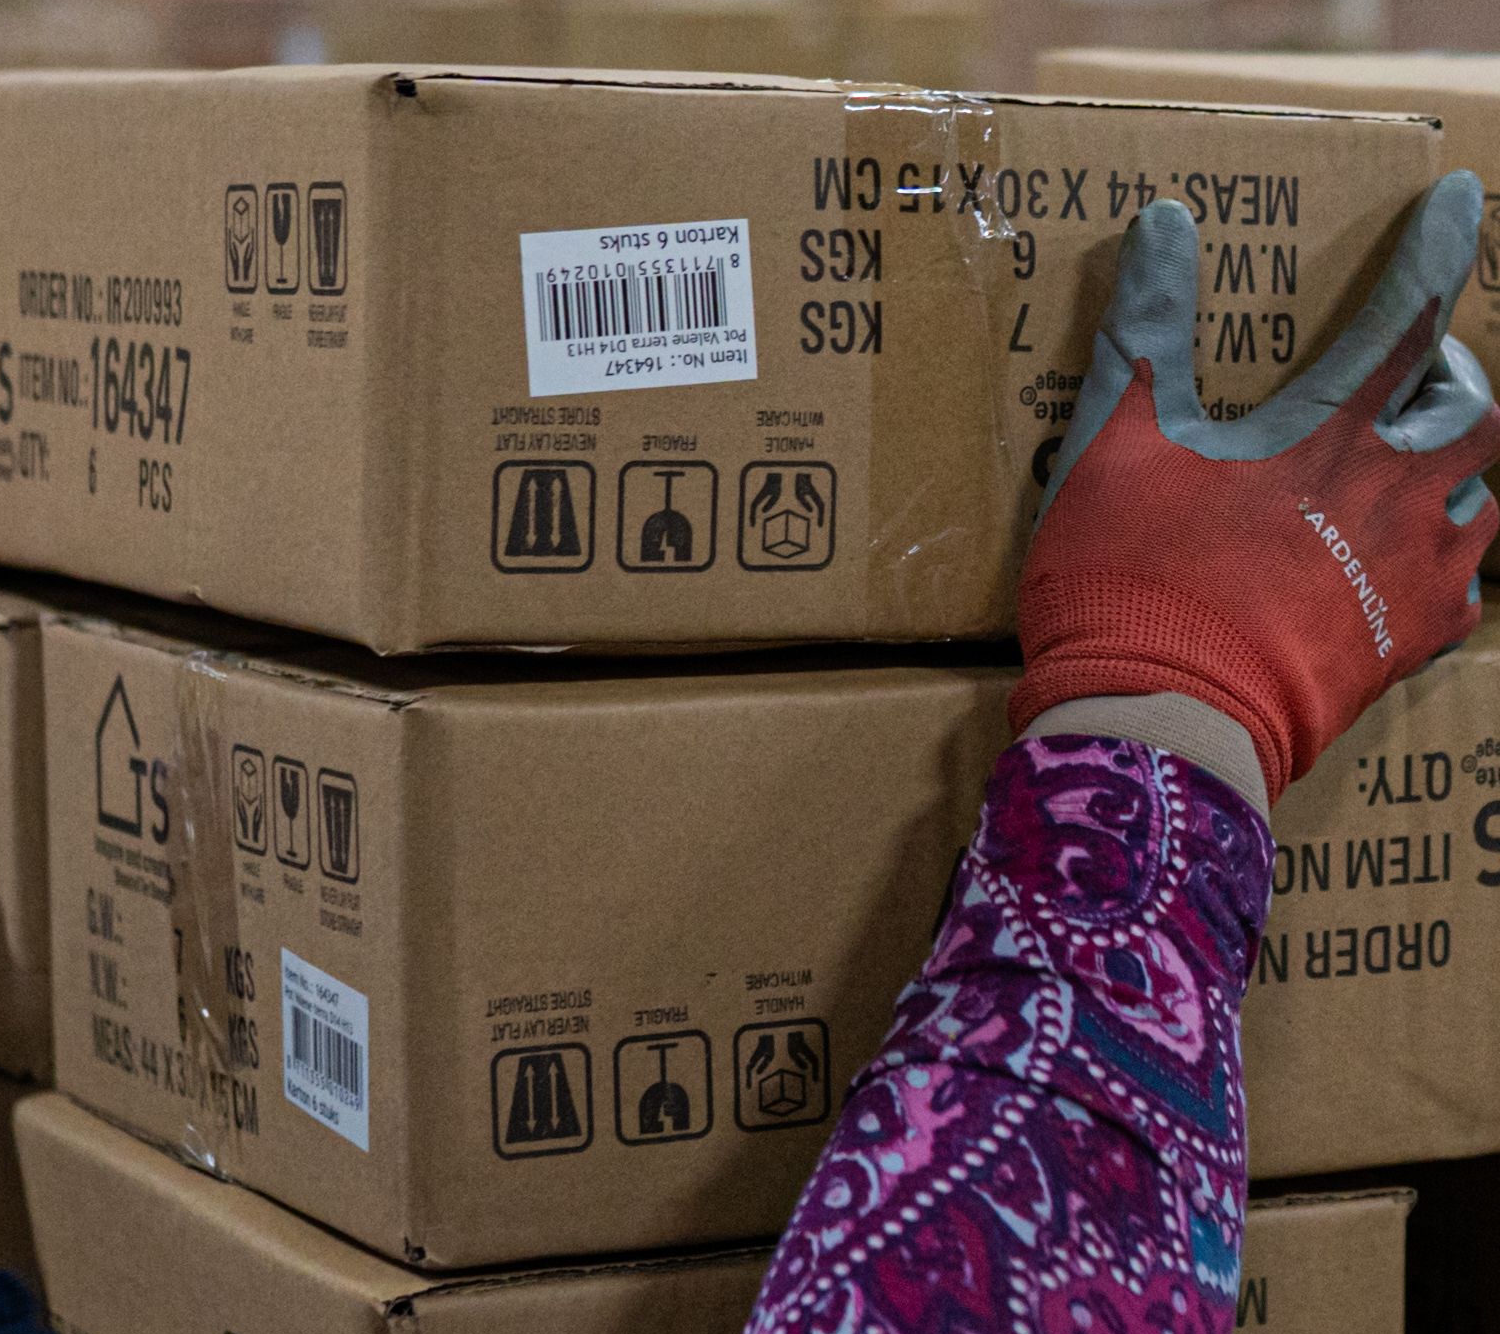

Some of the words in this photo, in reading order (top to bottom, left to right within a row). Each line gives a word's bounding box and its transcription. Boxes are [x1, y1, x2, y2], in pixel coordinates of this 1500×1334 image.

[814, 158, 880, 210] CM
[899, 162, 945, 212] 15
[1061, 171, 1088, 219] X
[1108, 175, 1153, 219] 44
[599, 232, 650, 252] stuks
[657, 232, 668, 249] 6
[675, 225, 739, 245] Karton
[731, 253, 739, 267] 8
[801, 229, 882, 282] KGS
[1012, 229, 1036, 279] 6
[547, 262, 626, 283] 010249
[638, 255, 714, 275] 711355
[18, 272, 67, 319] ORDER
[107, 276, 182, 327] IR200993
[724, 329, 746, 342] Pot
[801, 301, 882, 354] KGS
[1009, 305, 1031, 351] 7
[599, 339, 626, 353] D14
[632, 336, 667, 348] terra
[672, 331, 720, 346] Valene
[568, 343, 594, 357] H13
[710, 350, 748, 366] Item
[605, 357, 662, 376] 164347
[672, 354, 705, 367] No.:
[91, 336, 191, 445] 164347
[1034, 373, 1084, 395] eege
[492, 407, 559, 425] STRAIGHT
[561, 407, 600, 425] STORE
[757, 410, 791, 426] CARE
[793, 410, 824, 426] WITH
[495, 434, 526, 450] FLAT
[529, 434, 552, 450] LAY
[554, 434, 596, 450] NEVER
[643, 435, 696, 450] FRAGILE
[765, 437, 814, 453] HANDLE
[139, 458, 172, 511] PCS
[1358, 752, 1452, 806] QTY:
[1345, 832, 1451, 890] ITEM
[1307, 920, 1451, 979] ORDER
[487, 994, 547, 1017] STRAIGHT
[548, 990, 592, 1012] STORE
[756, 996, 805, 1015] HANDLE
[634, 1005, 689, 1026] FRAGILE
[492, 1022, 520, 1041] FLAT
[547, 1018, 589, 1037] NEVER
